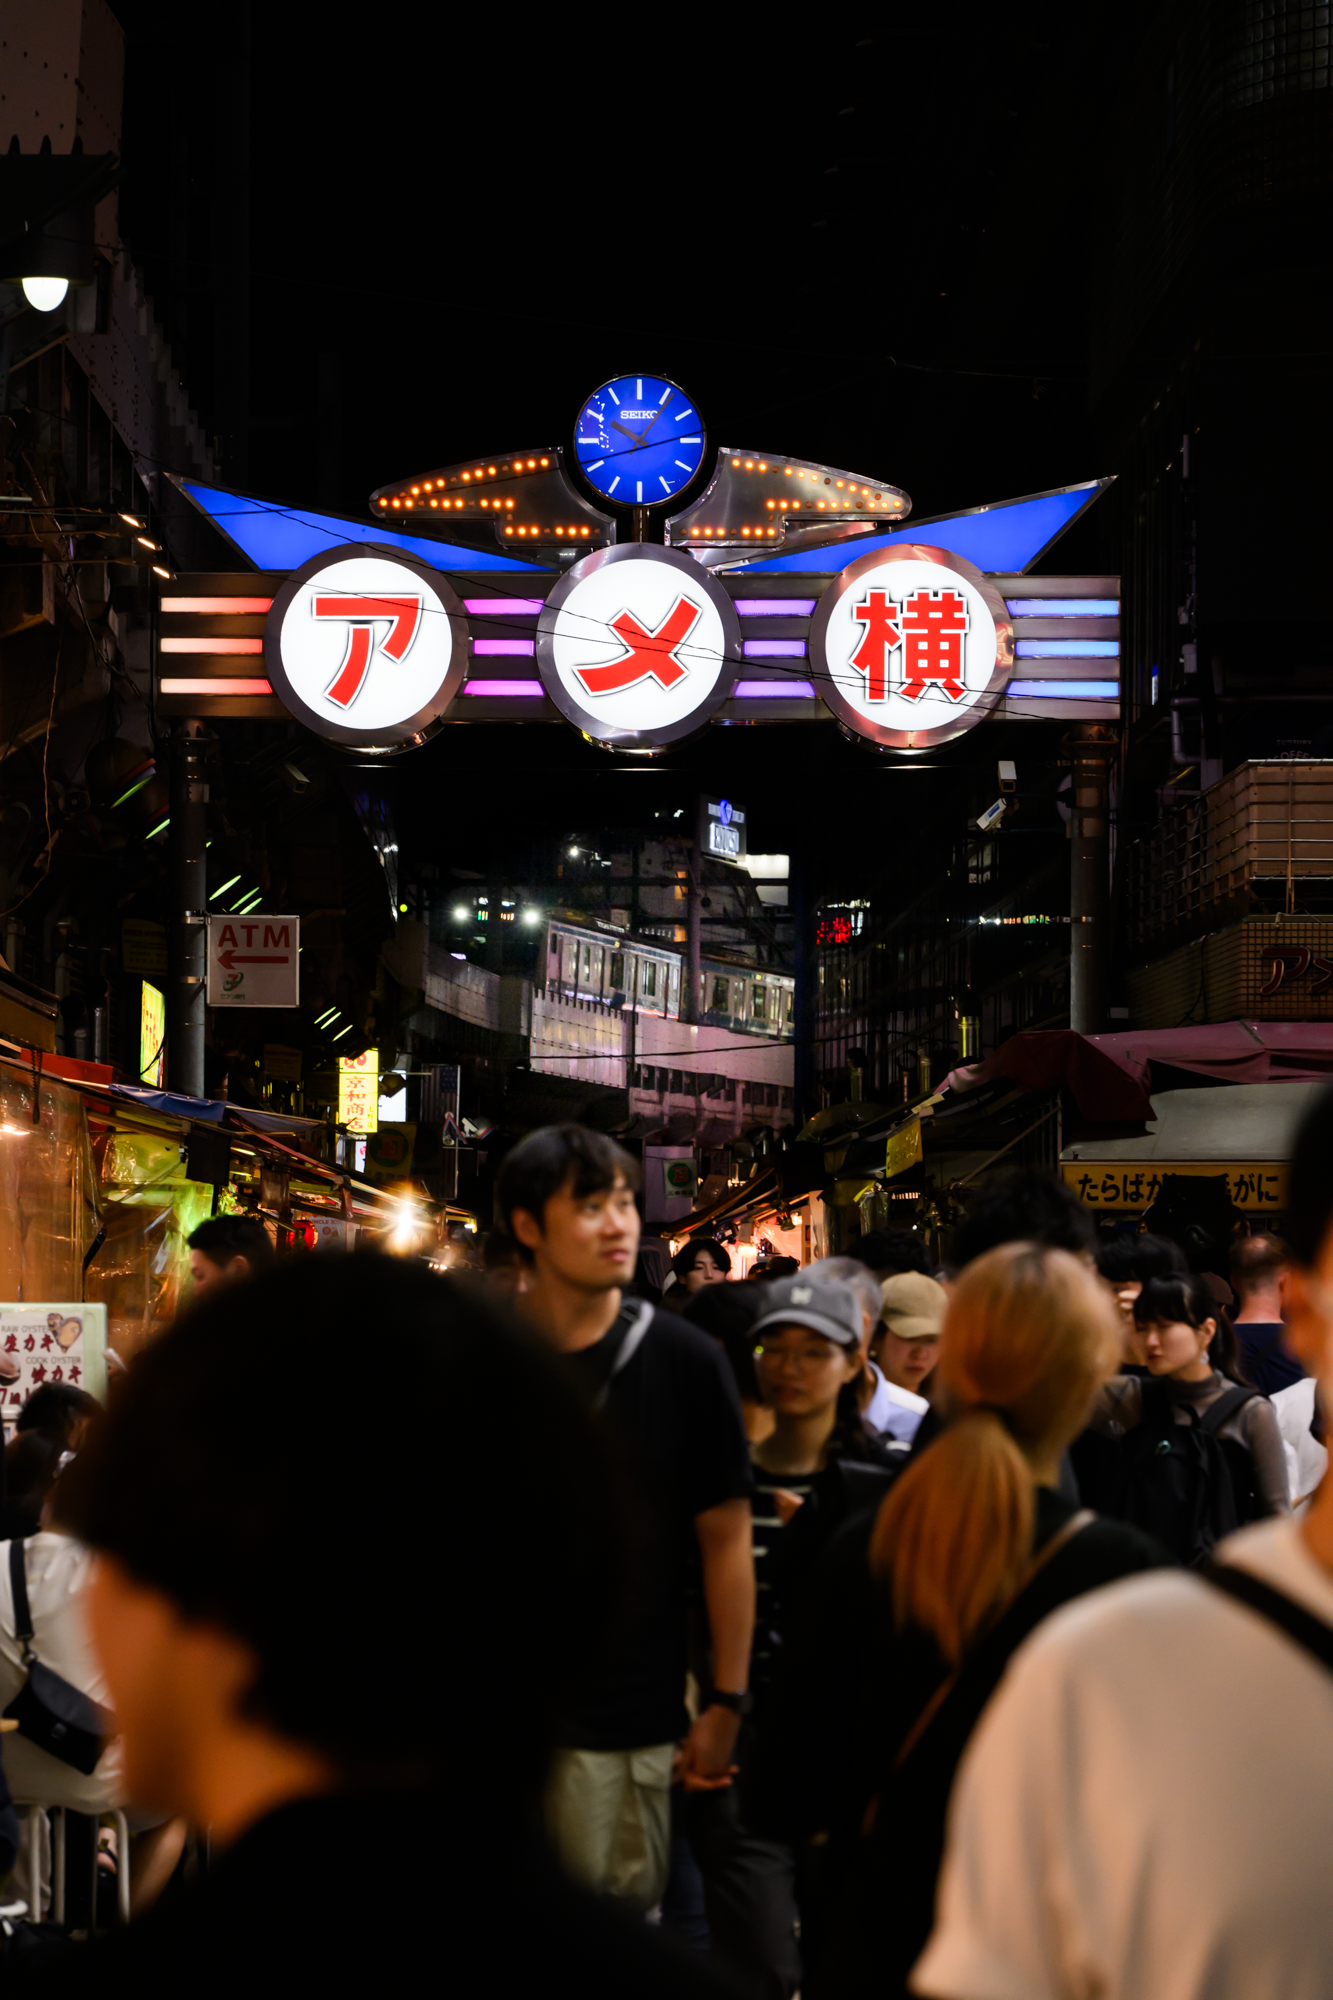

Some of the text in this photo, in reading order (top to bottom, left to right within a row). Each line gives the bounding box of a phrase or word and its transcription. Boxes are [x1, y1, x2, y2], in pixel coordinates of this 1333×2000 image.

[620, 410, 658, 419] SEIKO
[312, 589, 968, 708] アメ横
[217, 924, 290, 948] ATM
[345, 1075, 366, 1129] 京和商店
[1, 1325, 19, 1333] RAW
[4, 1333, 54, 1353] 生カキ
[25, 1356, 81, 1365] COOK OYSTER
